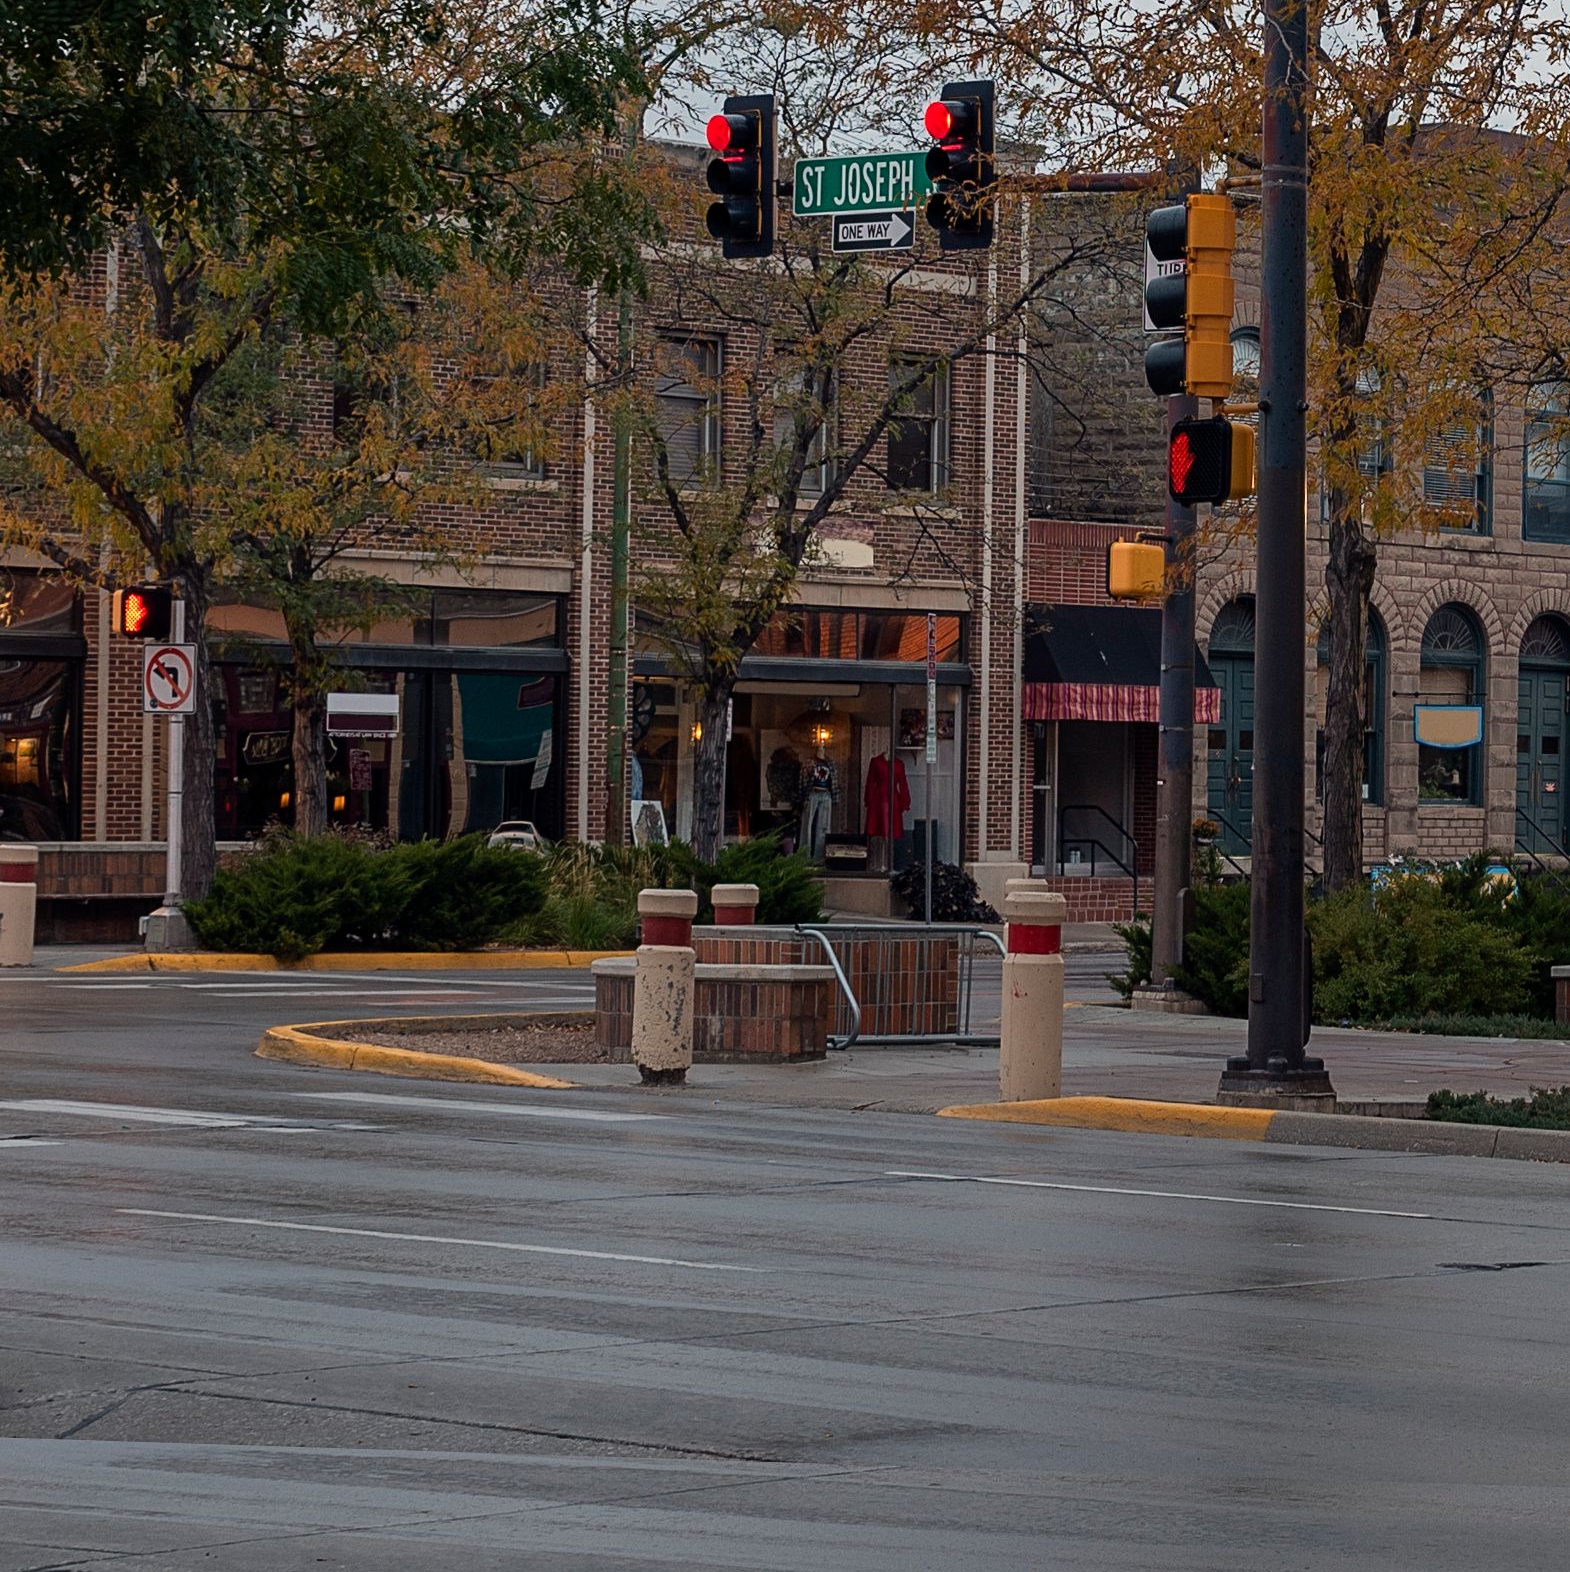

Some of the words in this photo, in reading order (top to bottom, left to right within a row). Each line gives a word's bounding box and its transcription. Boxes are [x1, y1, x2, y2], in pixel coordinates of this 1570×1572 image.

[801, 166, 825, 208] ST
[834, 160, 914, 205] JOSEPH
[841, 225, 863, 239] ONE
[867, 223, 890, 238] WAY
[1157, 263, 1186, 277] TUR
